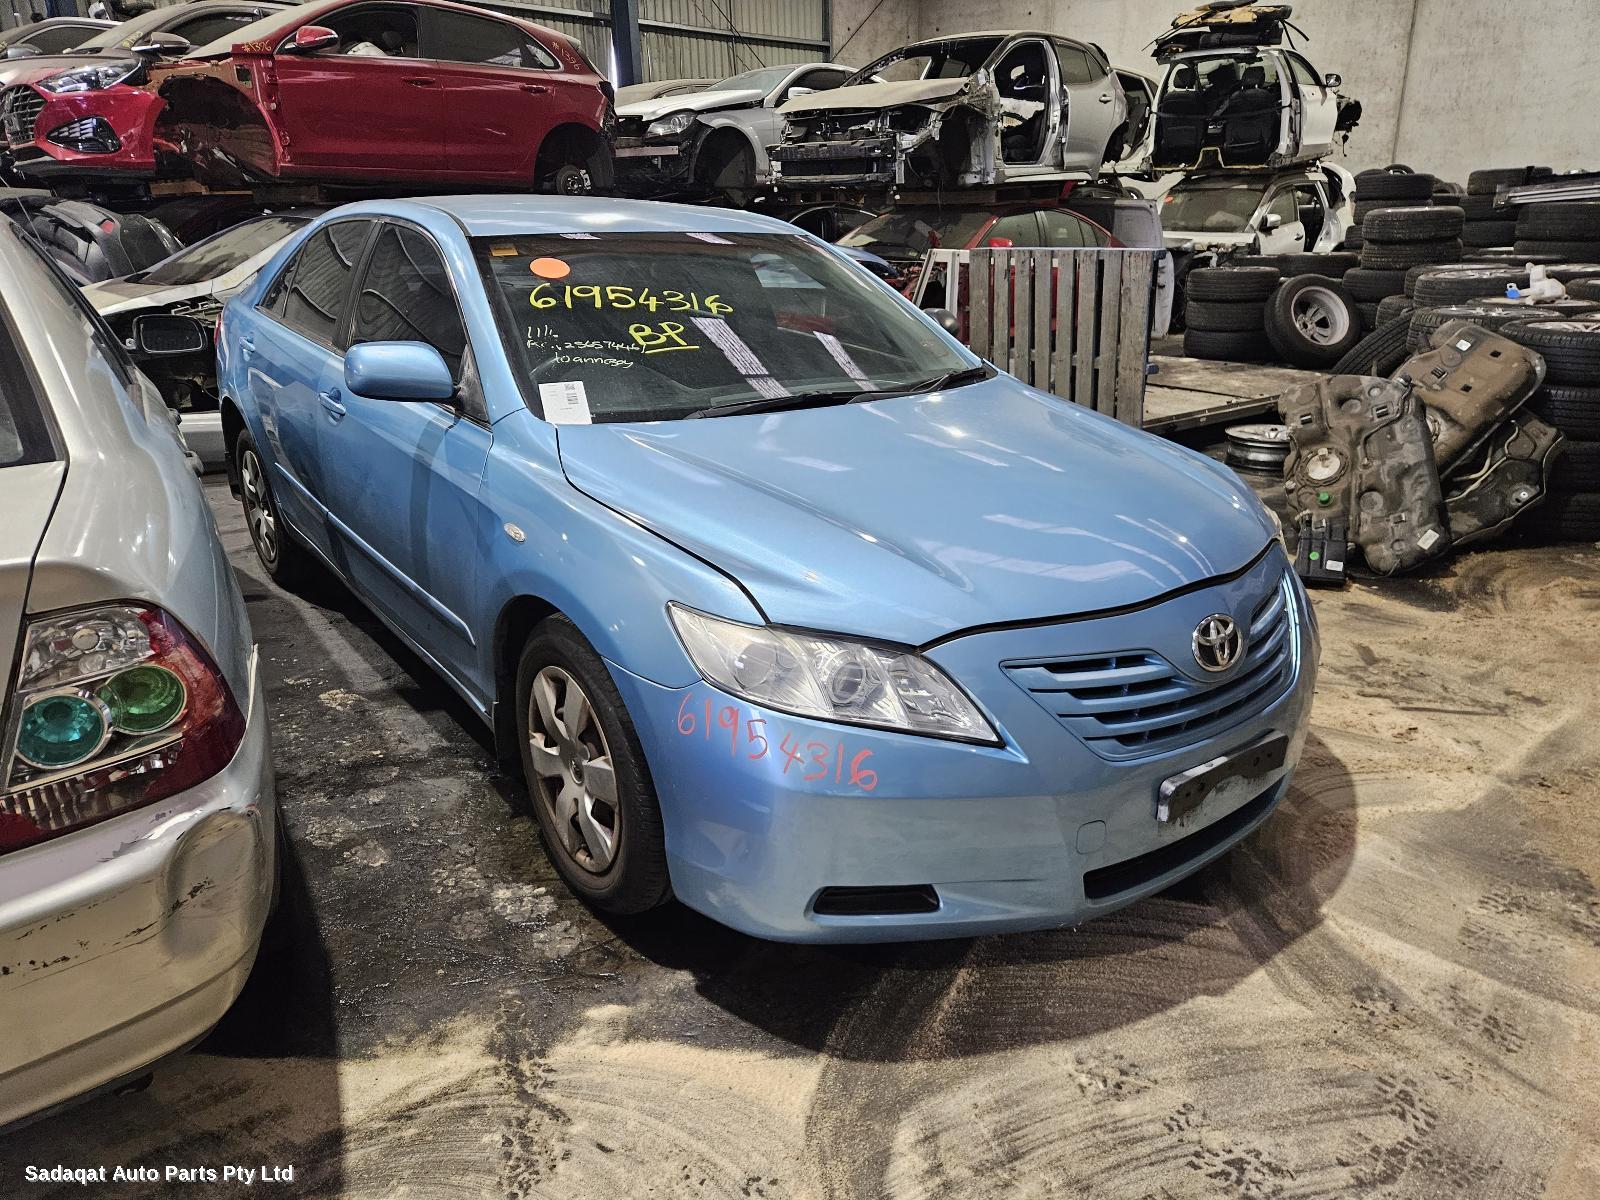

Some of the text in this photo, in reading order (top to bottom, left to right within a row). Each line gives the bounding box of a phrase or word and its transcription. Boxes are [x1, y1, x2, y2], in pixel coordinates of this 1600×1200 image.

[529, 282, 734, 316] 61954316
[628, 321, 688, 346] BP
[676, 692, 878, 791] 61954316
